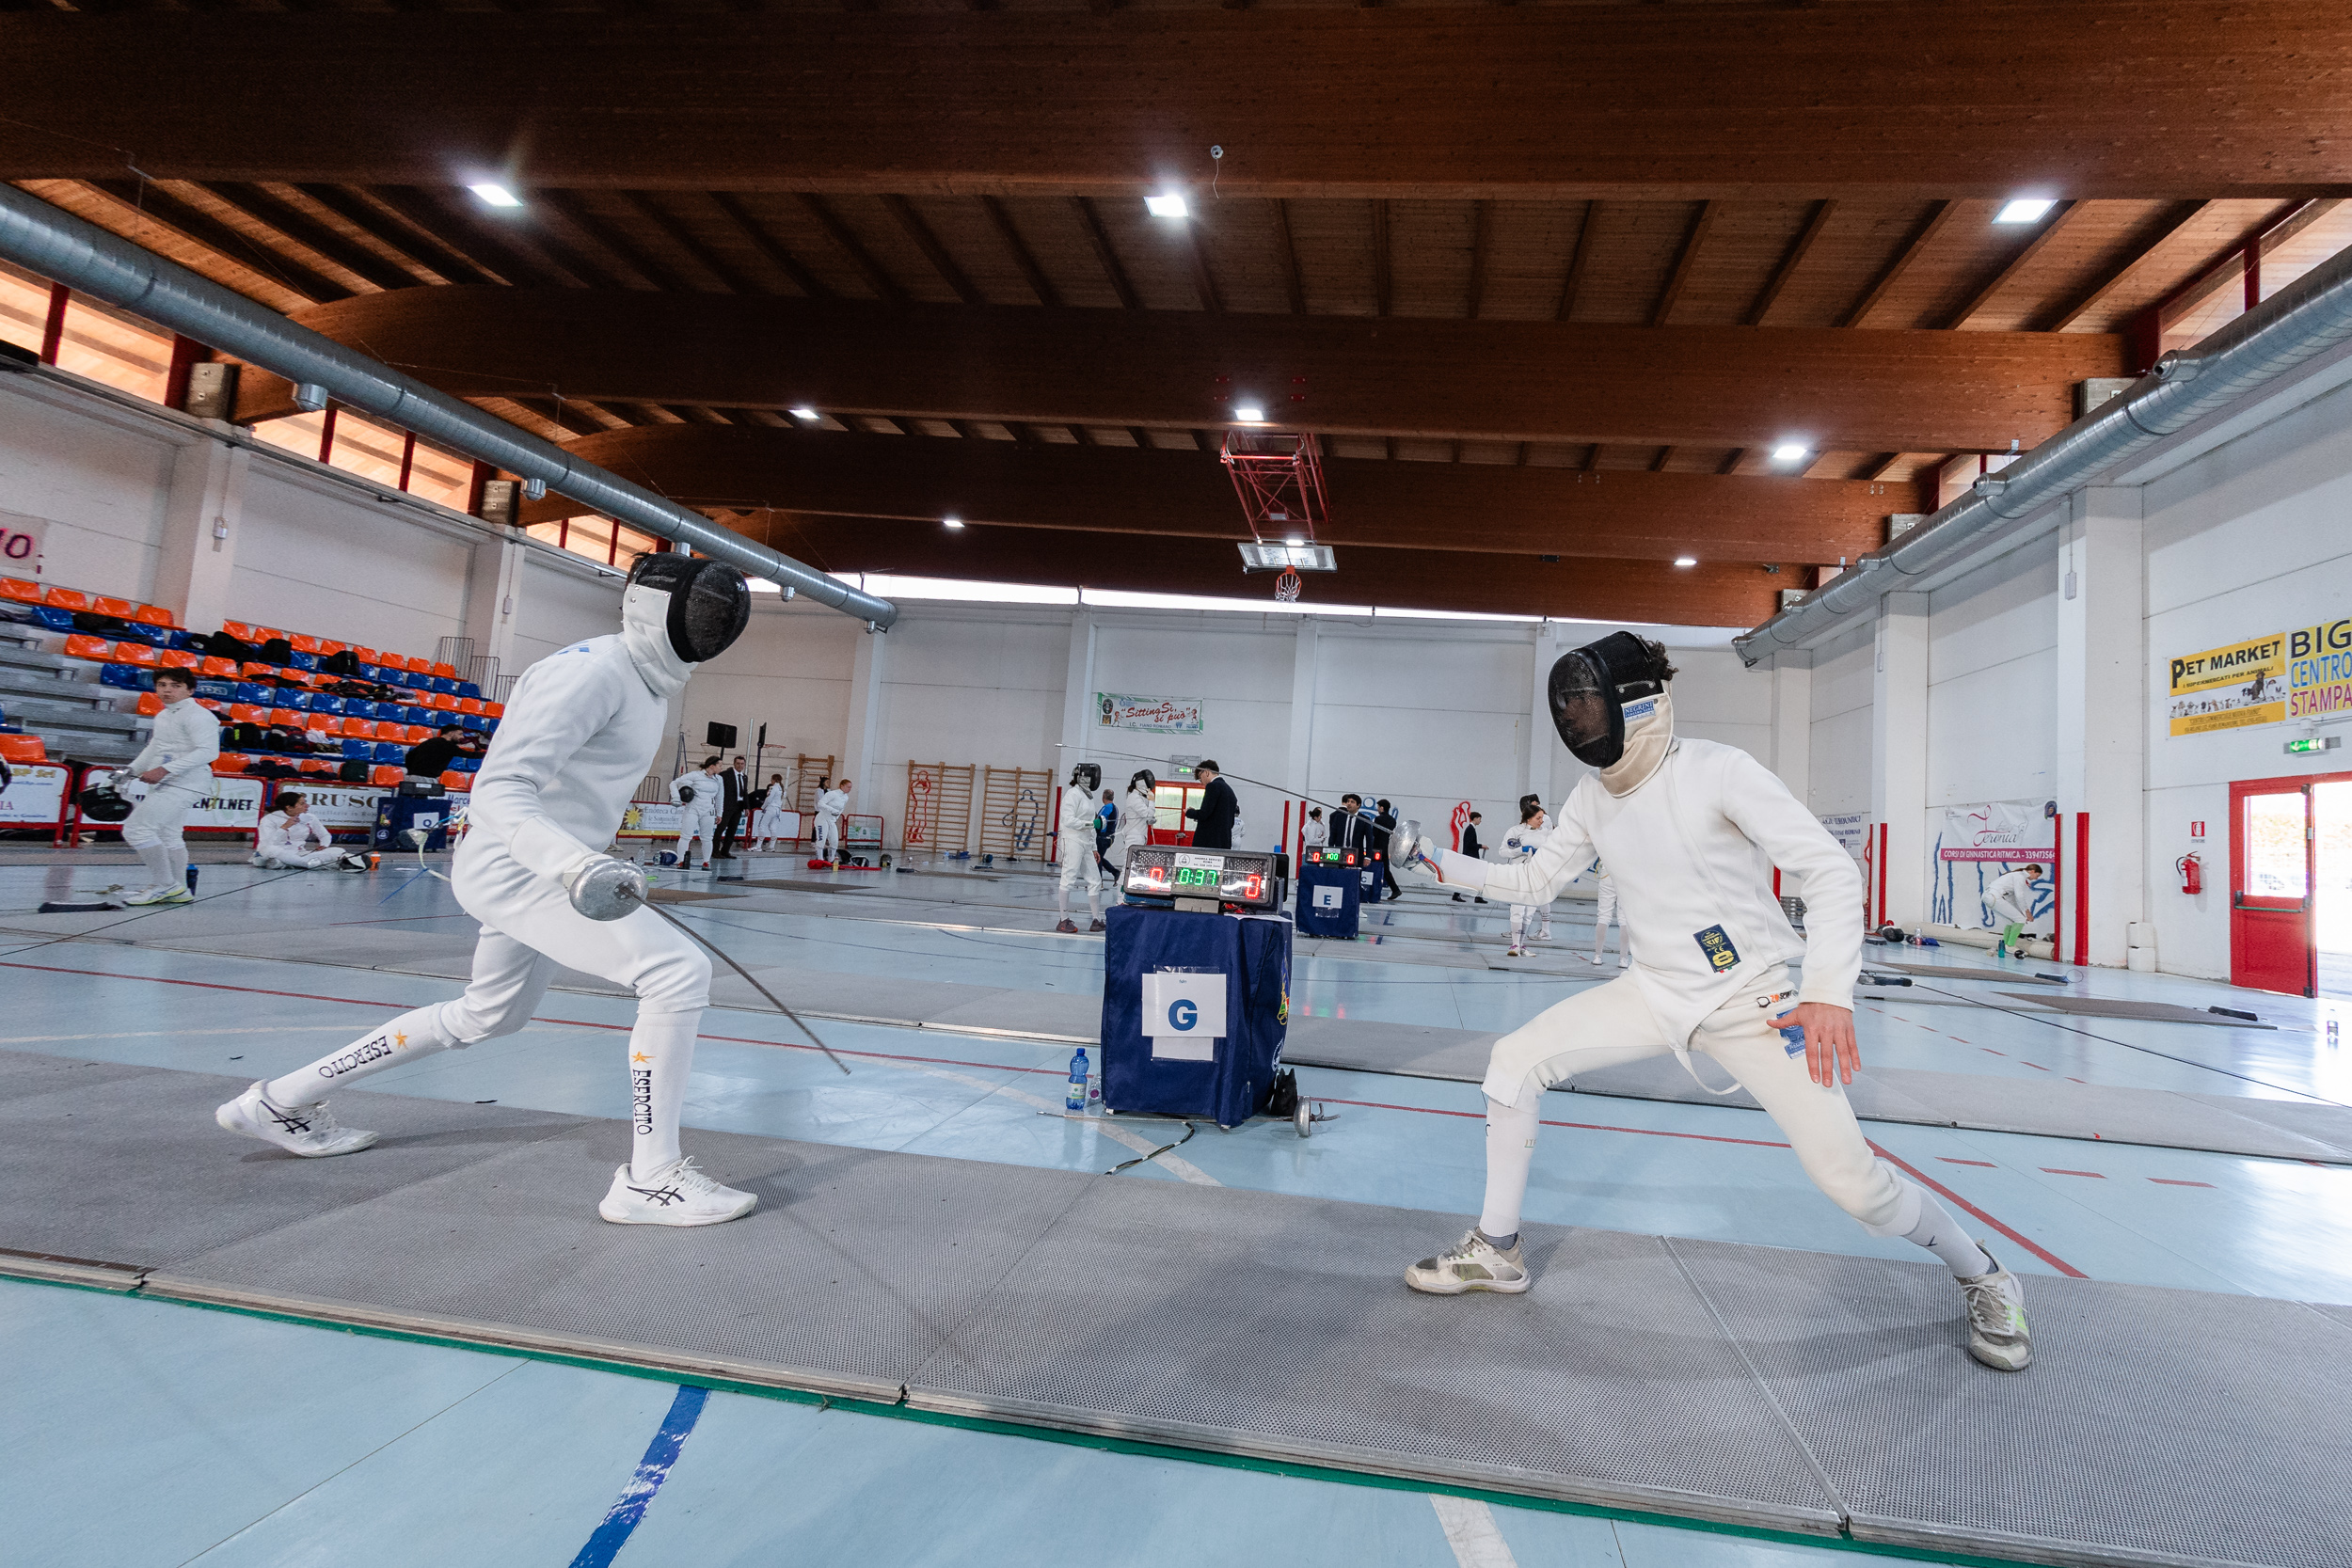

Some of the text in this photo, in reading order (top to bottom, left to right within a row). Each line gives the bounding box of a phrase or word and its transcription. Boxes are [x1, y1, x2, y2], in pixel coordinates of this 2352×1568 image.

[2290, 619, 2352, 659] BIG
[2171, 641, 2280, 689] PET MARKET
[2291, 651, 2352, 689] CENTRO
[2186, 674, 2231, 688] SUPERMERCATI
[2232, 672, 2245, 680] PER
[2247, 666, 2274, 675] ANIMALI
[1624, 701, 1653, 713] NEGRINI
[2291, 683, 2352, 717] STAMPA
[299, 792, 377, 810] RUS
[1312, 852, 1321, 863] 0
[1346, 854, 1355, 864] 0
[1944, 849, 1959, 858] CORSI
[1996, 850, 2021, 859] RITMICA
[1178, 867, 1217, 886] 0:37
[1323, 895, 1332, 906] E
[1168, 999, 1199, 1032] G
[318, 1035, 393, 1079] ESERCITO
[632, 1069, 653, 1135] ESERCITO
